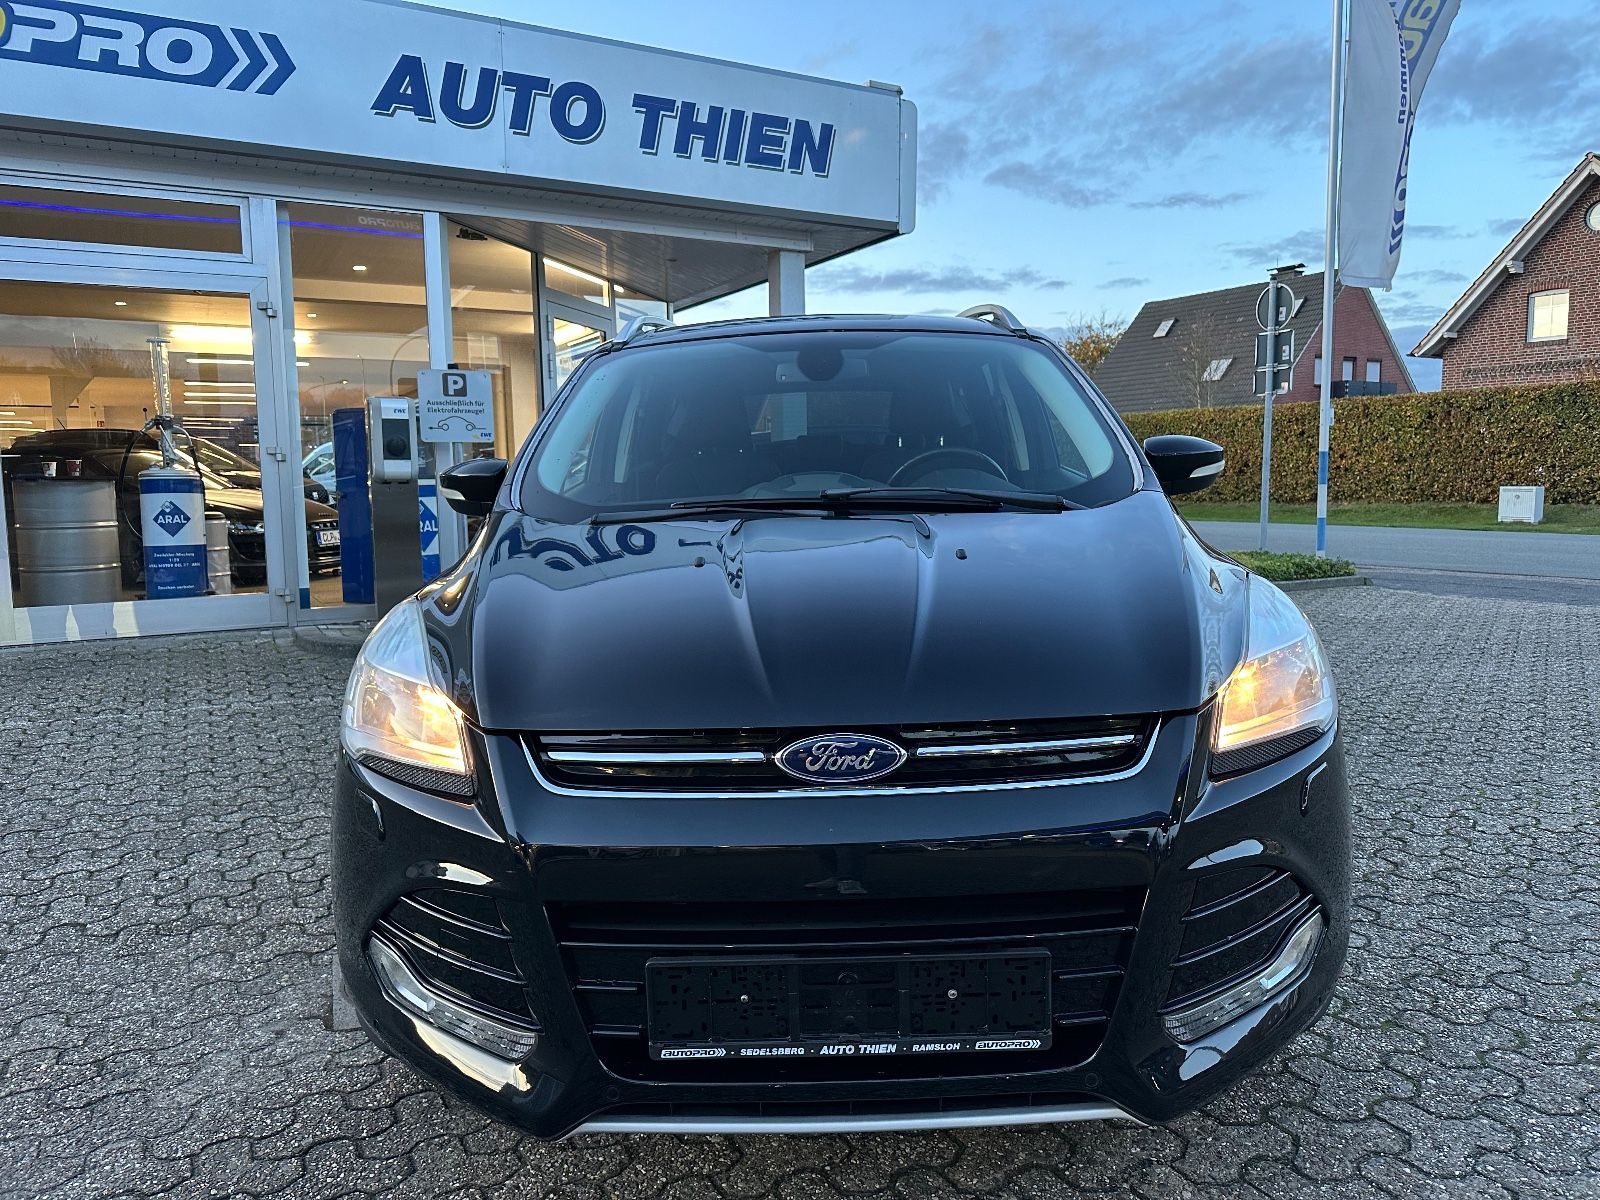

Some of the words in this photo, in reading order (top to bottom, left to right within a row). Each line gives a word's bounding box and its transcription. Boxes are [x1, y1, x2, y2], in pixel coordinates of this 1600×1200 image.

[0, 2, 213, 76] PRO
[370, 54, 607, 144] AUTO
[631, 92, 837, 178] THIEN
[426, 399, 475, 407] Ausschließlich
[157, 514, 188, 524] ARAL
[419, 519, 439, 532] RAL
[805, 741, 876, 772] Ford
[739, 1047, 805, 1056] SEDELSBERG
[819, 1045, 856, 1055] AUTO
[858, 1044, 897, 1054] THIEN
[912, 1042, 961, 1052] RAMSLOH
